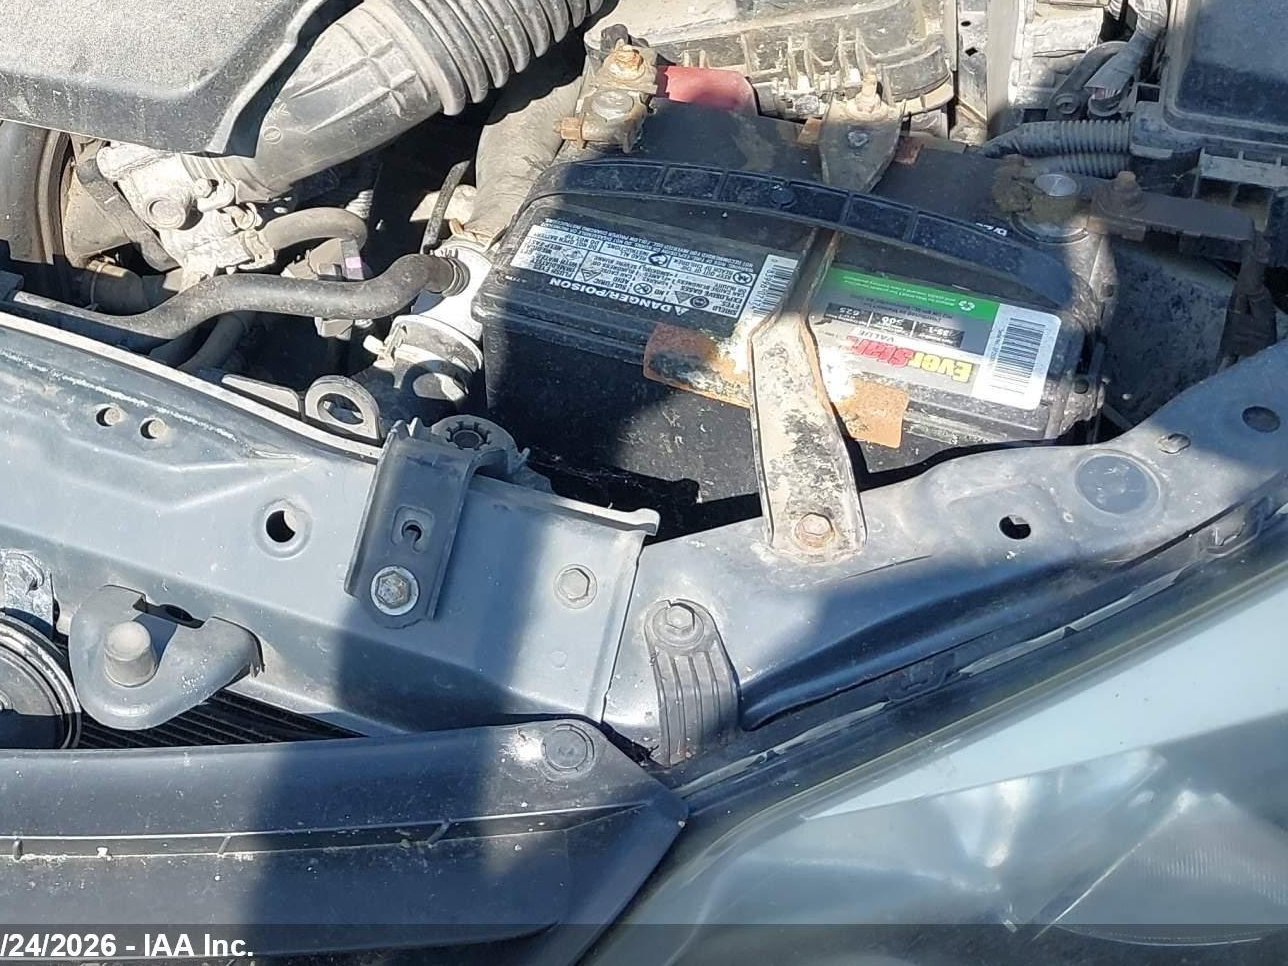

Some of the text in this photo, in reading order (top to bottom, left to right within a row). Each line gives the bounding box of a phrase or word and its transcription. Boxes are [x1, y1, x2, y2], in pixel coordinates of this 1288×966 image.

[548, 276, 673, 313] DANGER/POISON
[679, 284, 743, 304] EXPLOSIVE GASES
[710, 304, 738, 316] SHIELD
[837, 305, 860, 317] 625
